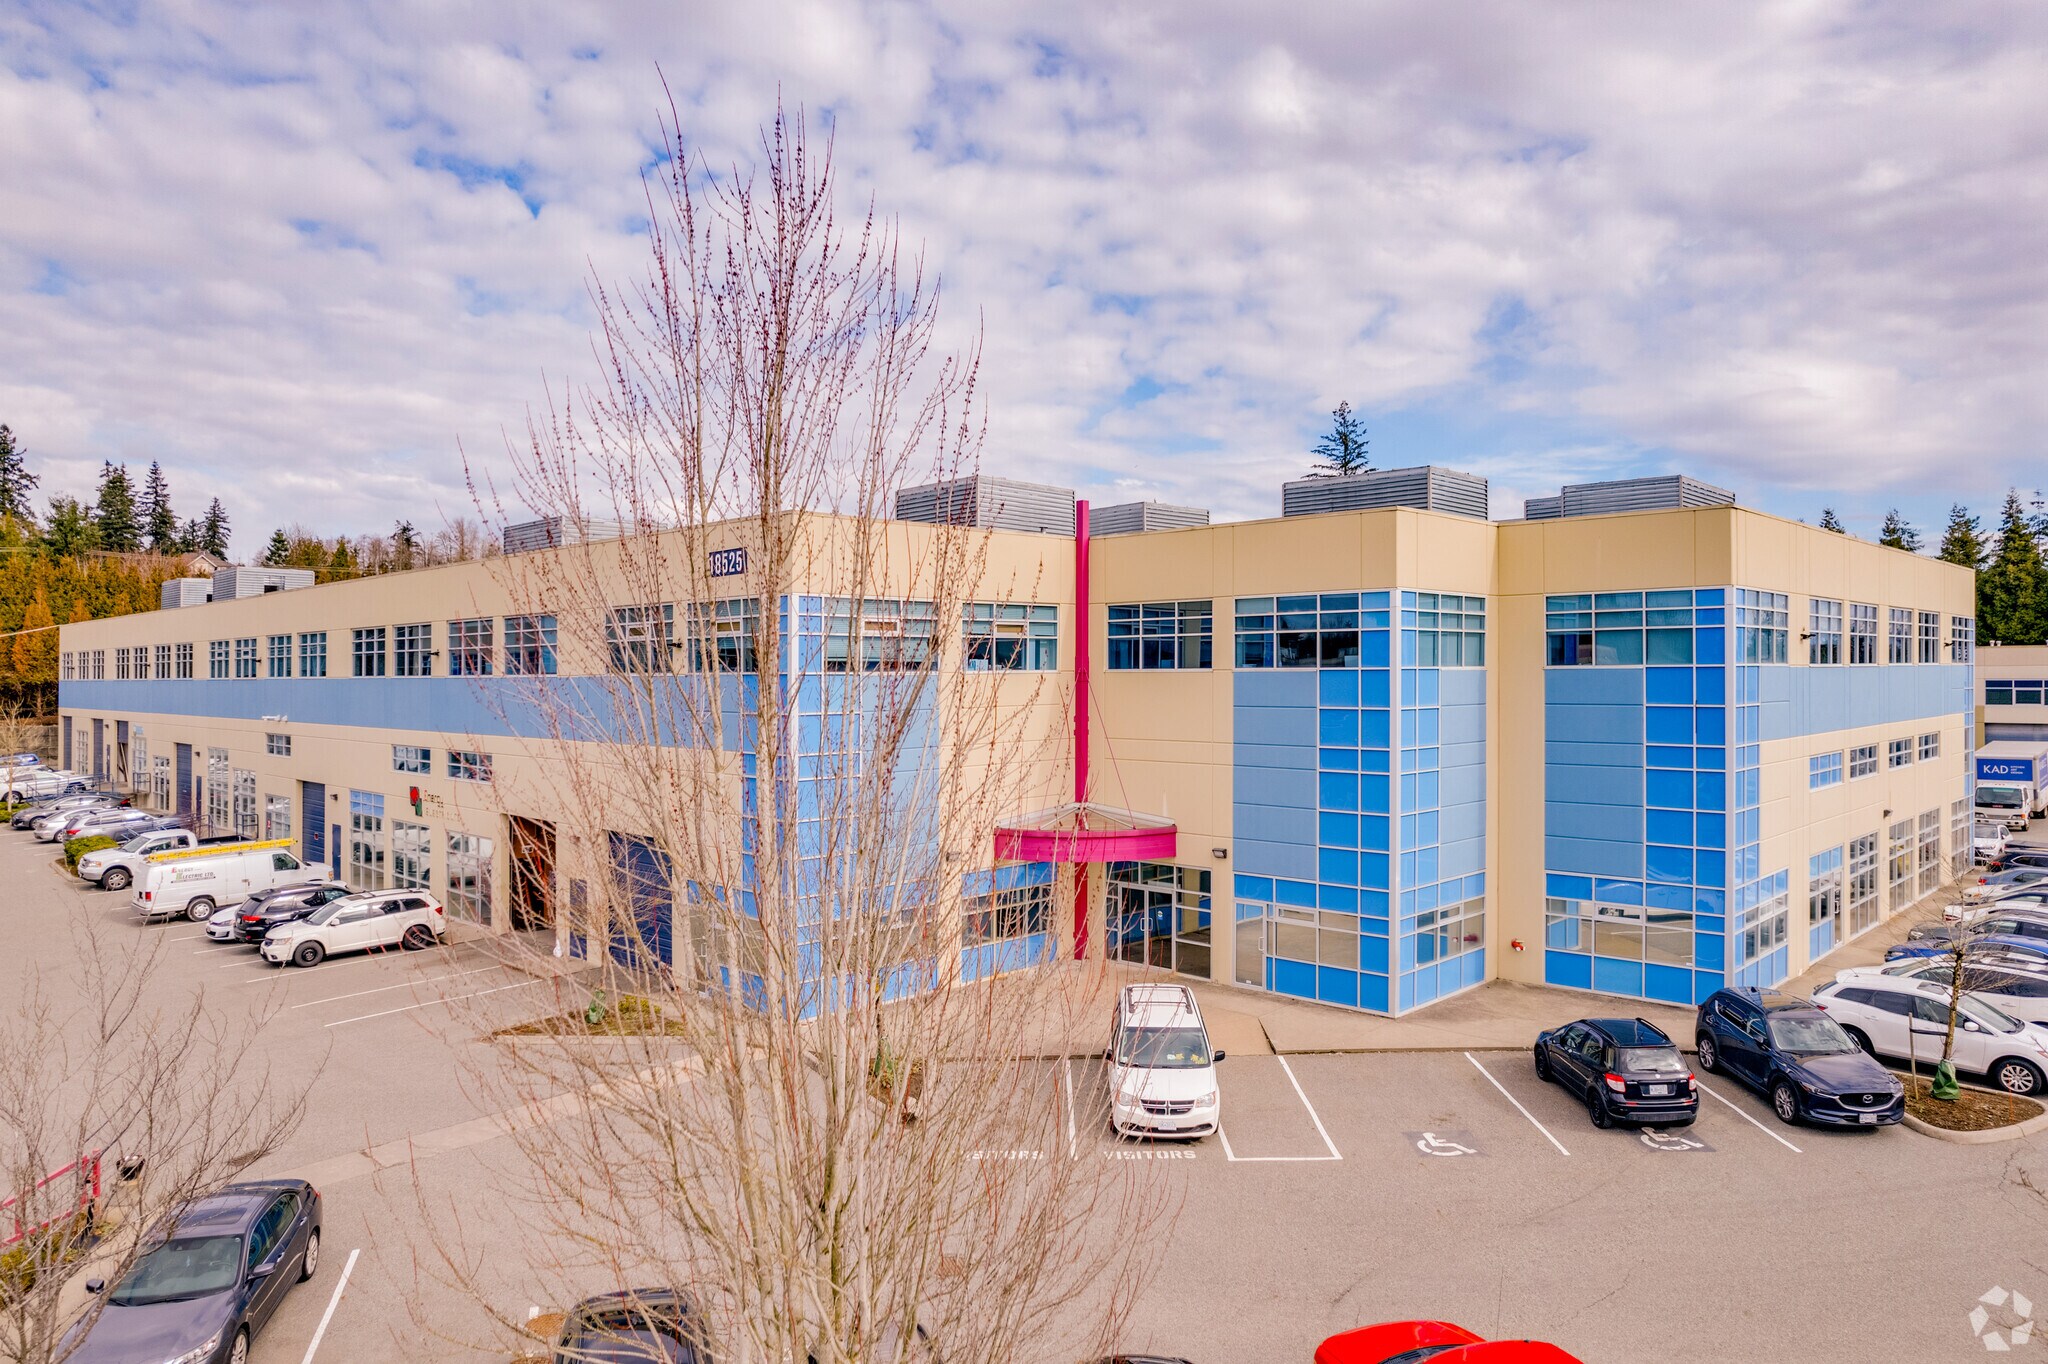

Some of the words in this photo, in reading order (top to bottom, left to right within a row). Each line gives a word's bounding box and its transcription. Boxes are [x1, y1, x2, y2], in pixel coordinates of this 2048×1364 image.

[710, 551, 743, 574] 18525
[1983, 765, 2009, 774] KAD
[1103, 1150, 1197, 1160] VISITORS
